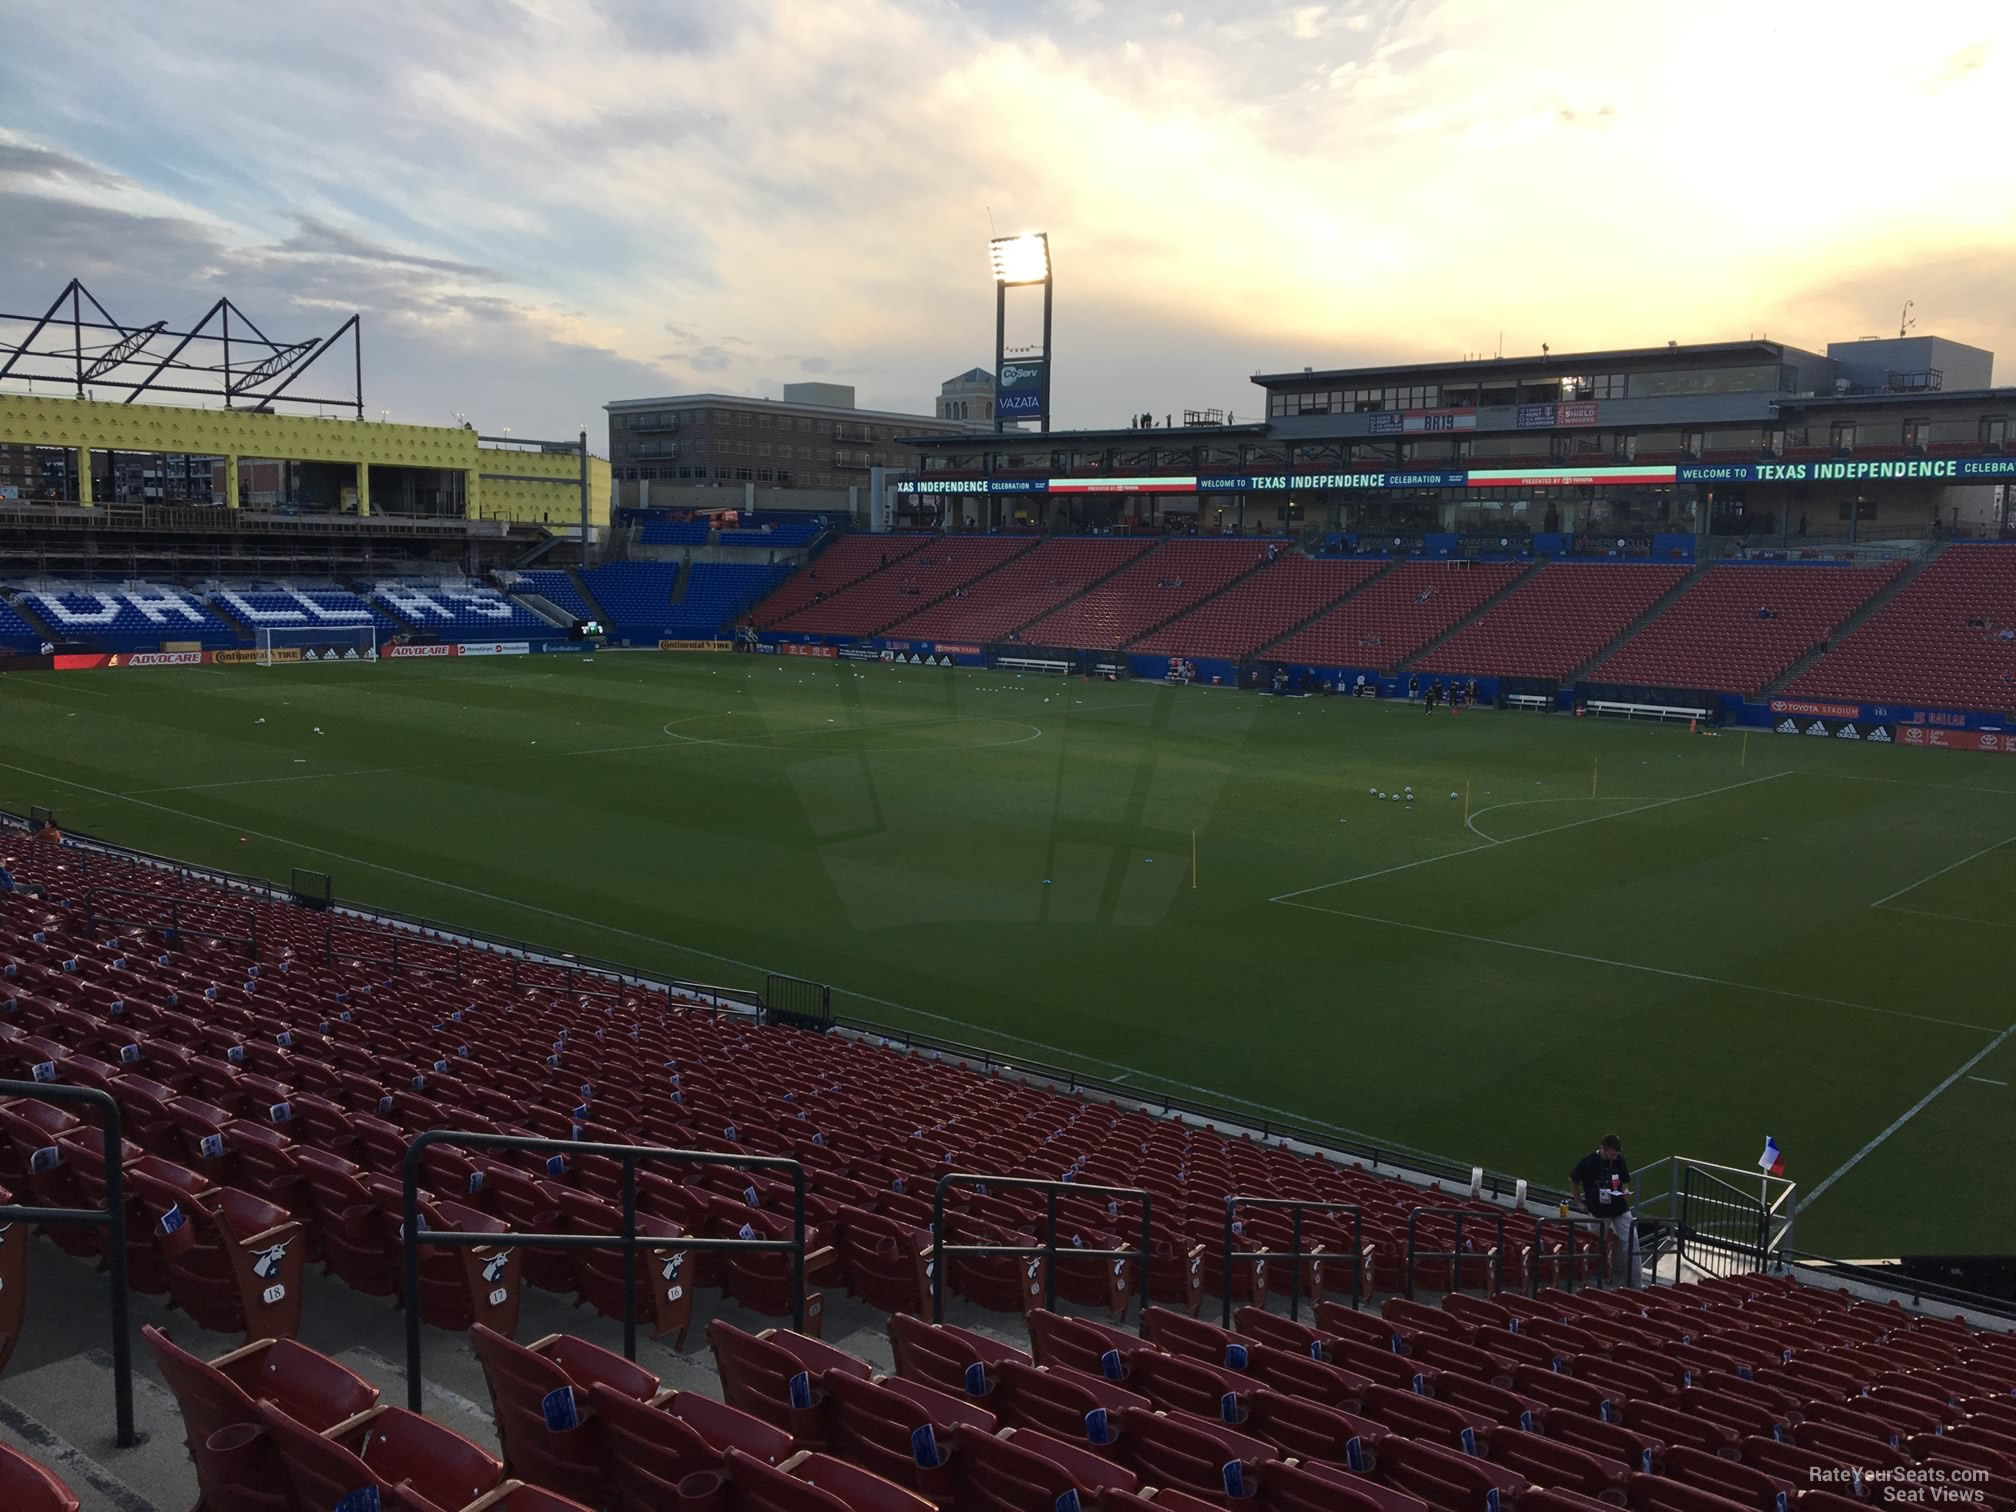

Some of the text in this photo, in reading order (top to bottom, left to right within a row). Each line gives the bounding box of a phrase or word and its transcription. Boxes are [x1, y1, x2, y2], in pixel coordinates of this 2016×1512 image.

[1003, 368, 1038, 378] CoServ
[999, 396, 1040, 409] VAZATA
[1565, 410, 1595, 418] SHIELD
[1682, 461, 2016, 480] WELCOME TO TEXAS INDEPENDENCE CELEBRA
[917, 480, 989, 492] INDEPENDENCE
[991, 482, 1030, 490] CELEBRATION
[1200, 479, 1235, 488] WELCOME
[1237, 479, 1246, 487] TO
[1251, 476, 1286, 489] TEXAS
[1290, 474, 1385, 488] INDEPENDENCE
[1389, 475, 1441, 484] CELEBRATION
[391, 645, 449, 657] ADVOCARE
[660, 640, 705, 650] Continental
[128, 652, 201, 666] ADVOCARE
[215, 651, 271, 662] Continental
[277, 651, 298, 659] TIRE
[1788, 703, 1858, 716] TOYOTA STADIUM
[1914, 711, 1966, 727] FC DALLAS
[1805, 729, 1829, 737] adidas
[1836, 732, 1860, 740] adidas
[1867, 734, 1892, 742] adidas
[267, 1287, 282, 1299] 18
[493, 1290, 504, 1302] 17
[670, 1288, 680, 1298] 16
